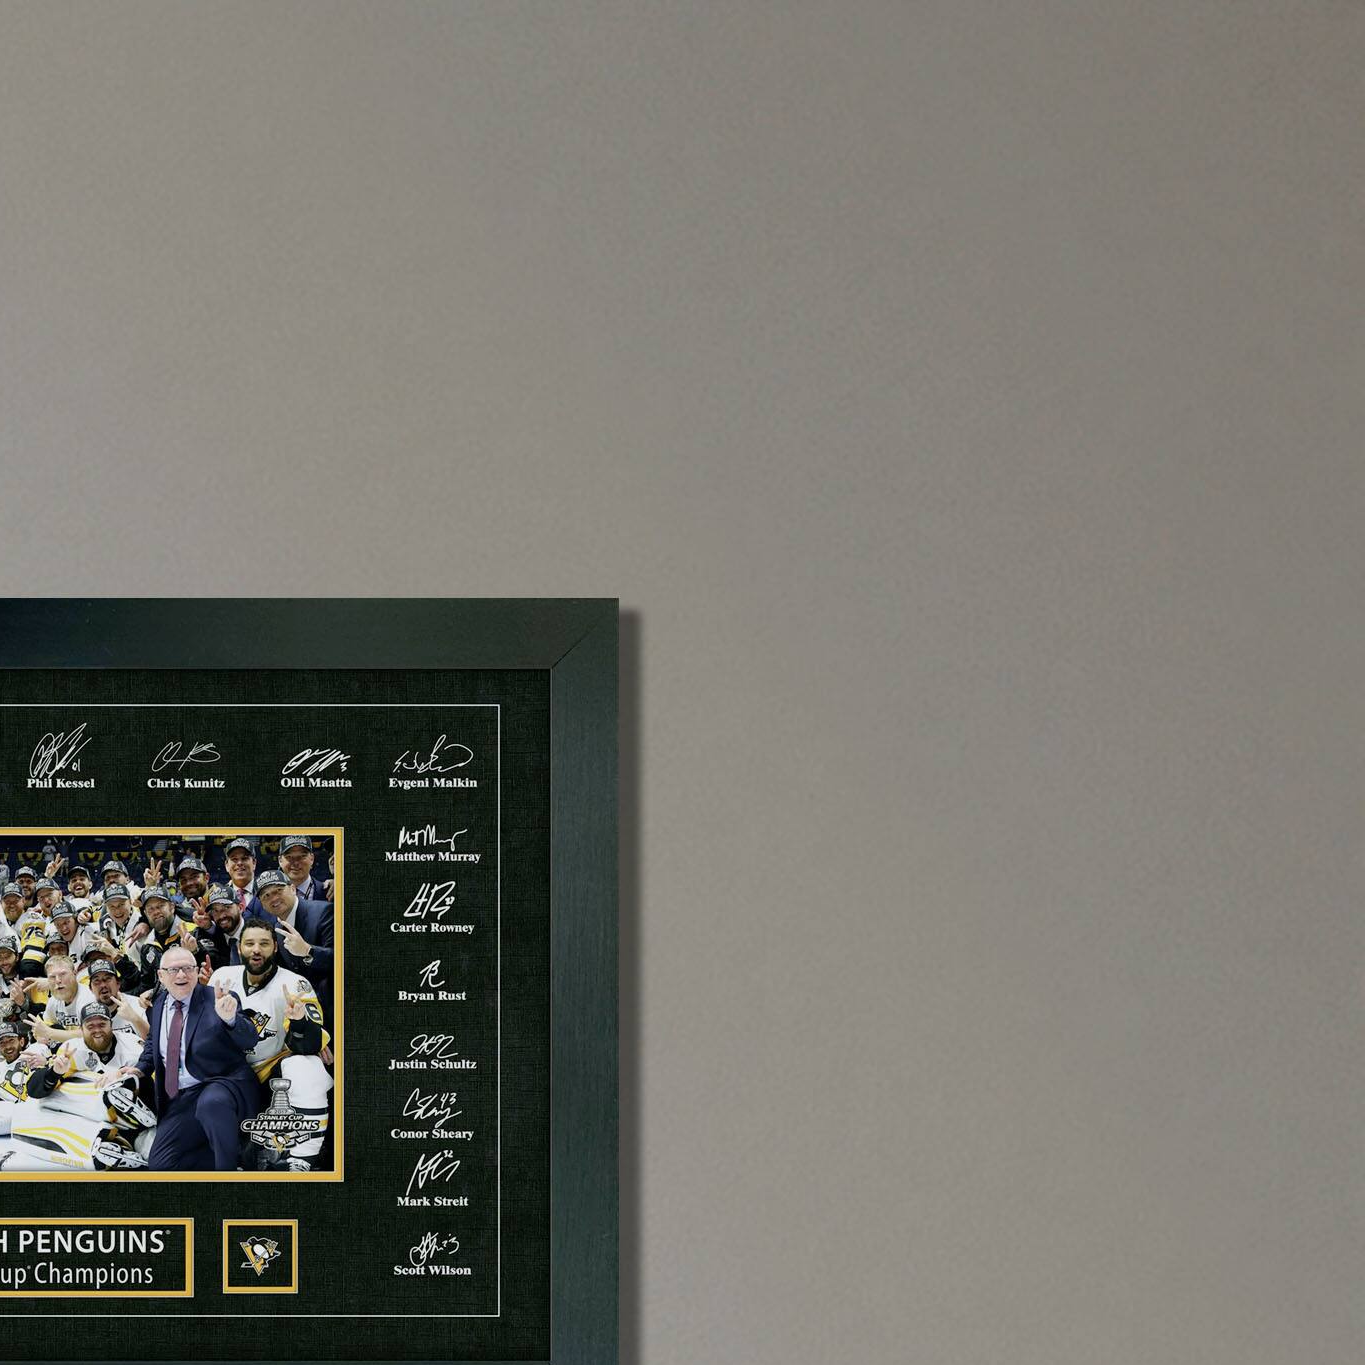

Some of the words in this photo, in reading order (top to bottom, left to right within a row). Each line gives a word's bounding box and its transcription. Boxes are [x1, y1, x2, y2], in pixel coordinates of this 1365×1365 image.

[27, 778, 52, 788] Phil
[56, 778, 94, 788] Kessel
[147, 778, 180, 788] Chris
[184, 778, 225, 788] Kunitz
[281, 778, 304, 787] Olli
[309, 778, 352, 787] Maatta
[389, 778, 429, 790] Evgeni
[433, 778, 477, 787] Malkin
[385, 852, 435, 861] Matthew
[438, 852, 481, 863] Murray
[391, 923, 427, 932] Carter
[431, 923, 474, 934] Rowney
[398, 991, 434, 1002] Bryan
[438, 991, 466, 1000] Rust
[389, 1060, 427, 1070] Justin
[431, 1060, 476, 1069] Schultz
[242, 1120, 319, 1130] CHAMPIONS
[391, 1129, 429, 1138] Conor
[432, 1129, 474, 1140] Sheary
[397, 1196, 431, 1206] Mark
[434, 1196, 468, 1206] Streit
[394, 1265, 425, 1275] Scott
[429, 1265, 471, 1275] Wilson
[35, 1262, 153, 1289] Champions
